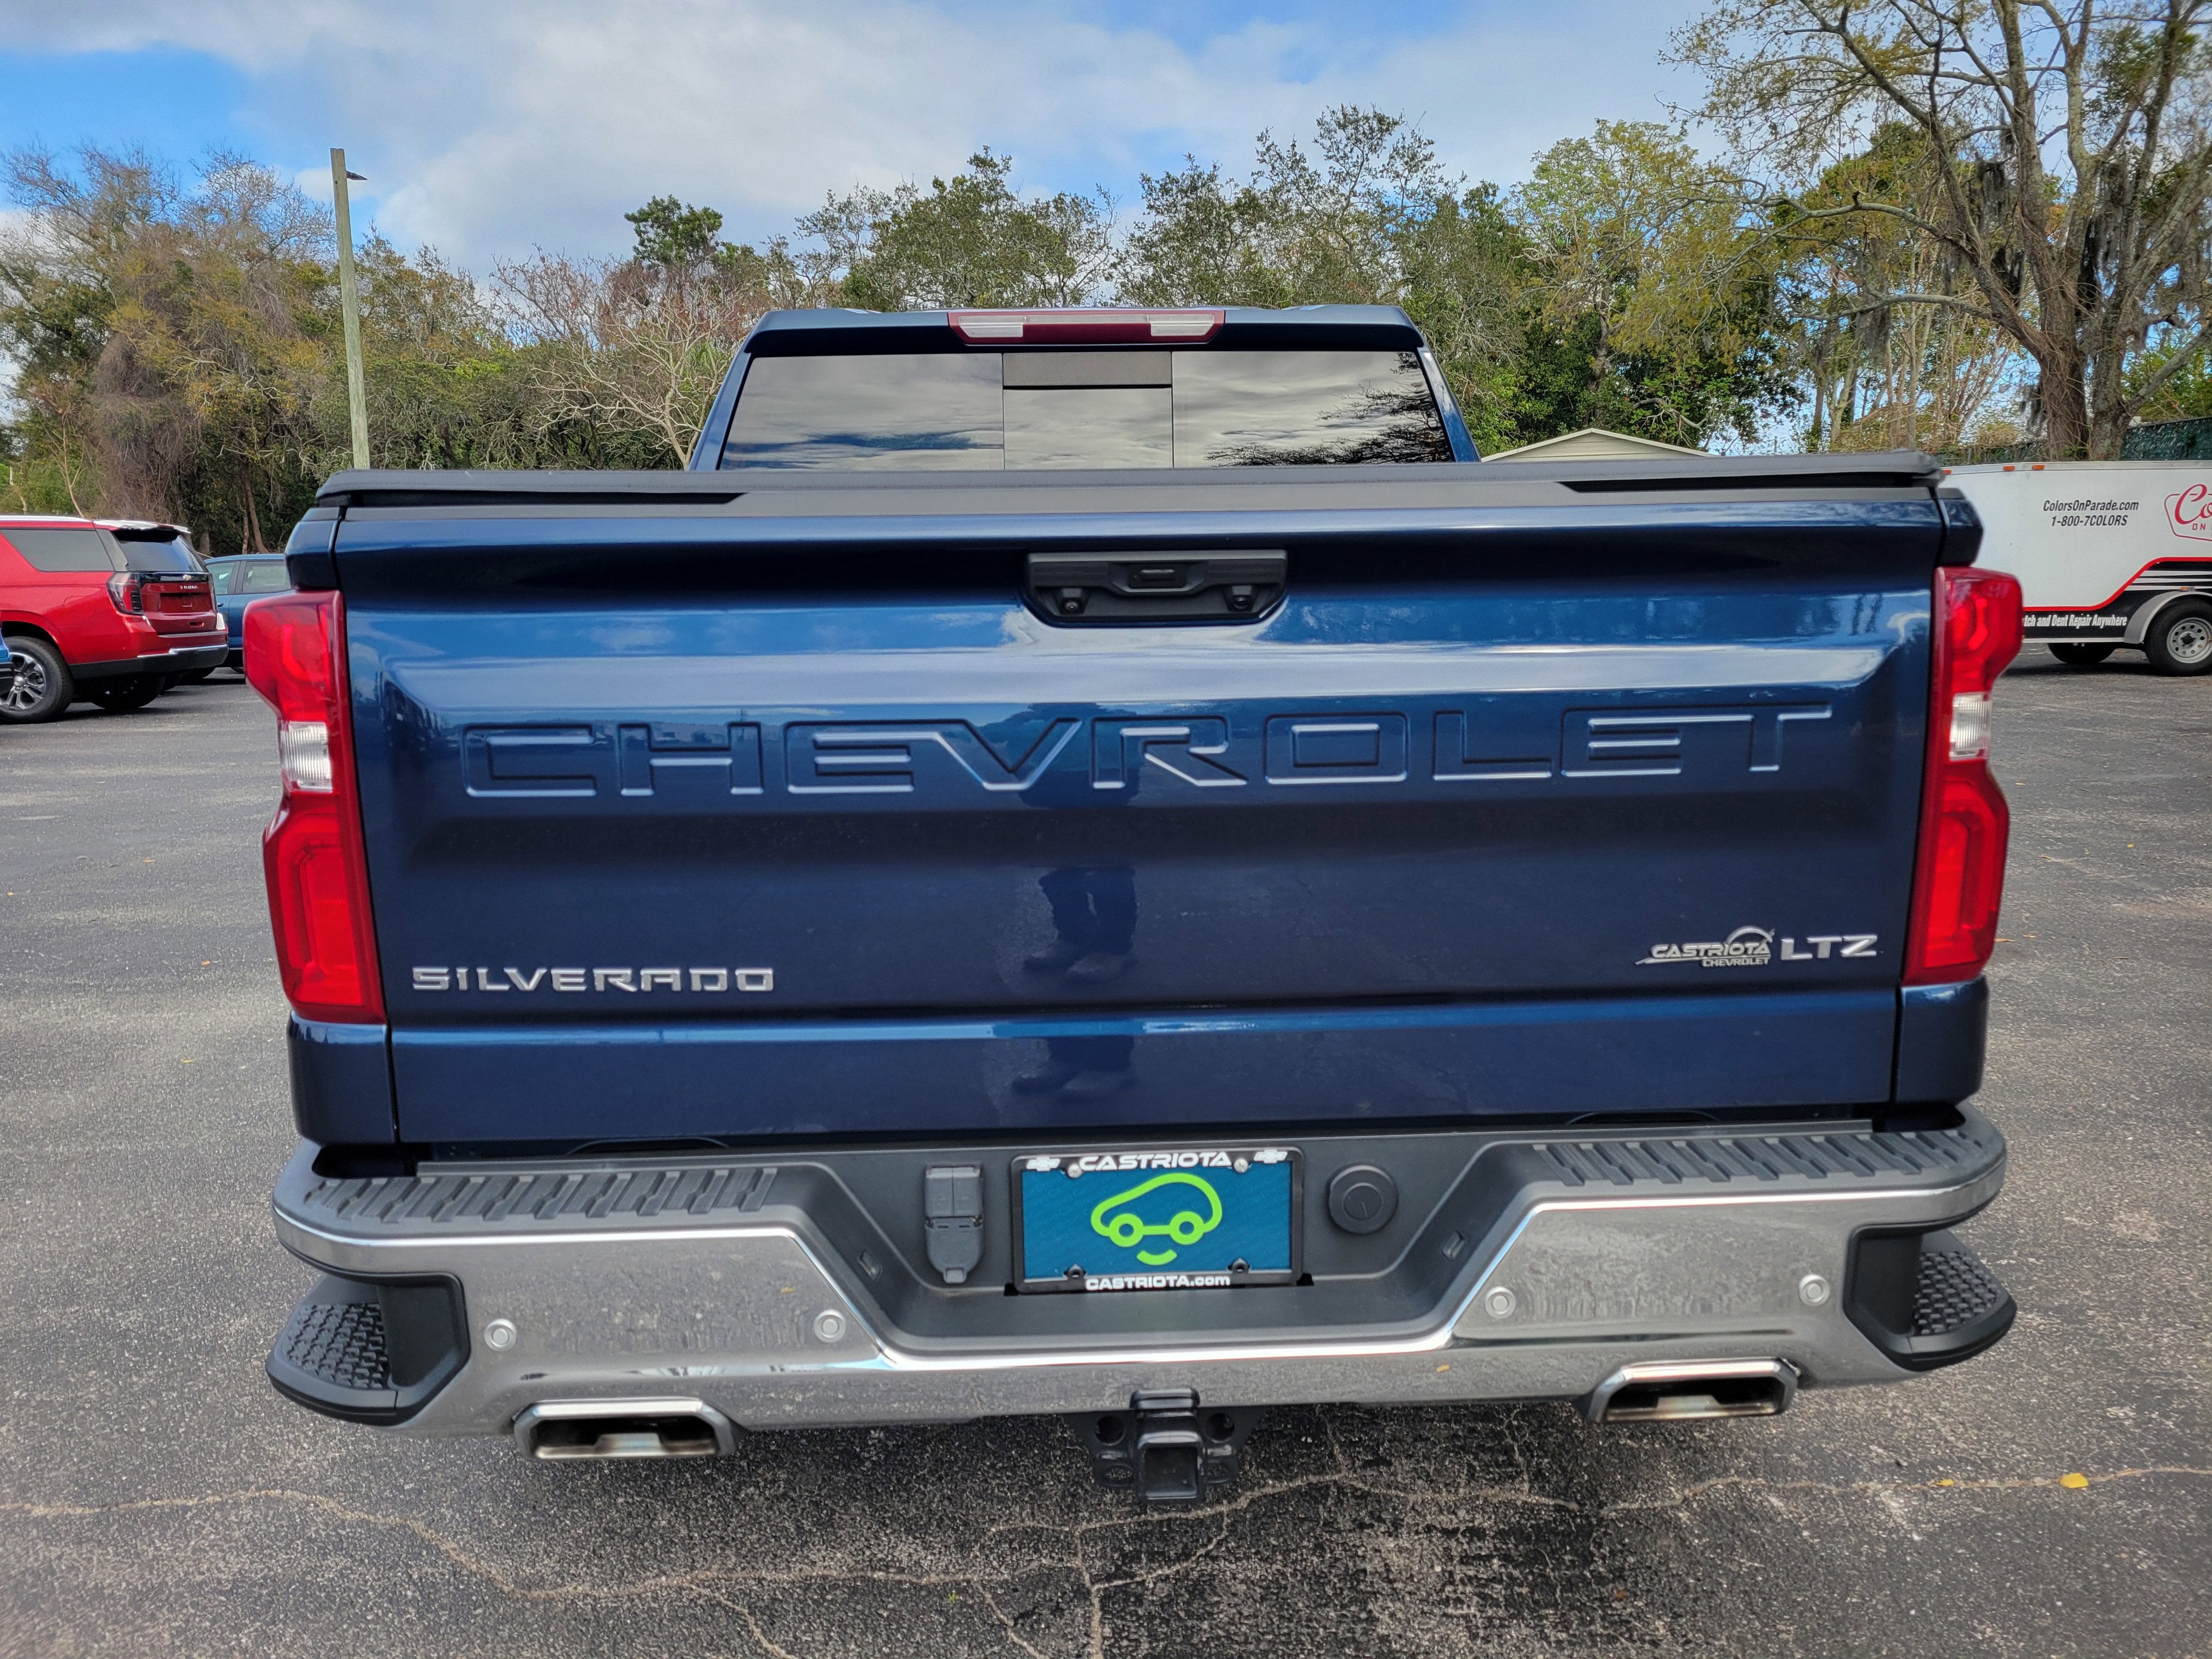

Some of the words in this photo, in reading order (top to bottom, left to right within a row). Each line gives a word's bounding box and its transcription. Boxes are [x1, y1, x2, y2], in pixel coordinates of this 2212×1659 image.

[2043, 500, 2139, 511] ColorsOnParade.com
[2051, 515, 2128, 527] 1-800-7COLORS
[2022, 614, 2036, 627] tch
[2036, 614, 2051, 627] and
[2051, 614, 2068, 627] Dent
[2068, 614, 2092, 629] Repair
[2091, 614, 2128, 629] Anywhere
[462, 702, 1832, 797] CHEVROLET
[1651, 941, 1770, 959] CASTRIOTA
[1781, 934, 1878, 960] LTZ
[1702, 957, 1770, 967] CHEVROLET
[412, 967, 774, 992] SILVERADO
[1079, 1151, 1232, 1172] CASTRIOTA
[1085, 1275, 1231, 1291] CASTRIOTA.com
